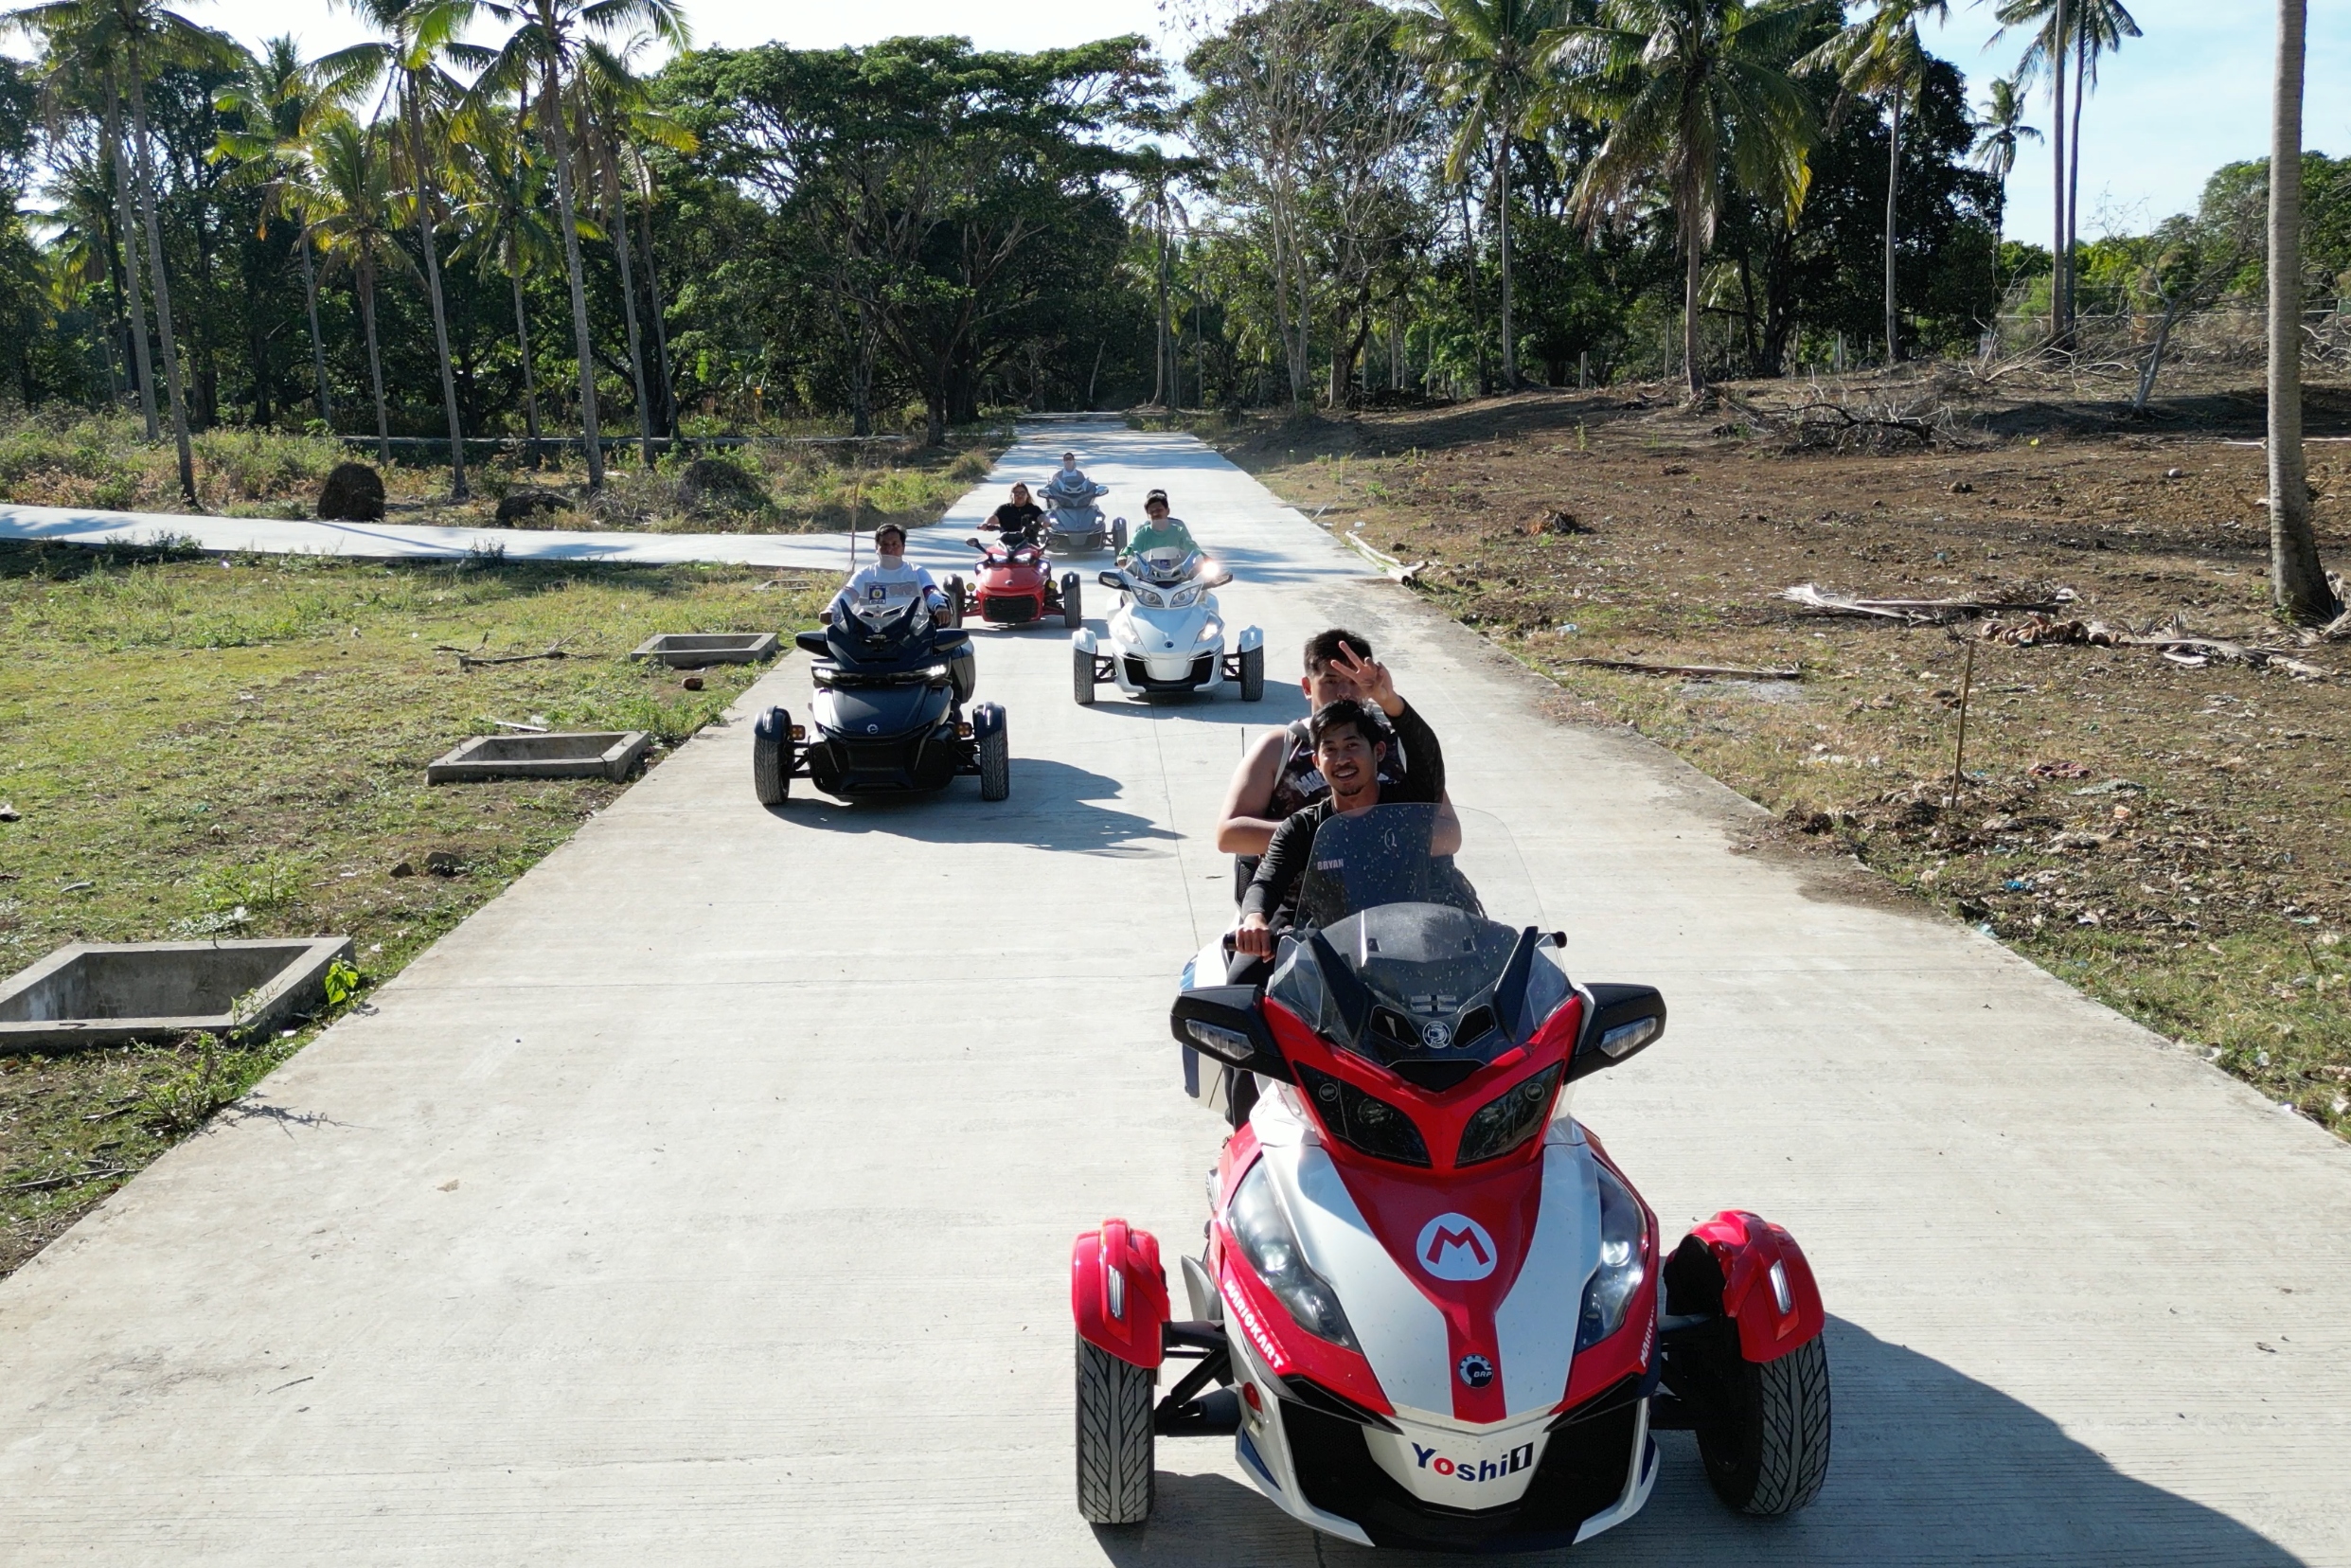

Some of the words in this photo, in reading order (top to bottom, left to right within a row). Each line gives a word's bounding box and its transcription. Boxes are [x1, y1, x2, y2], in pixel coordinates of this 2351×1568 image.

[1317, 858, 1345, 871] BRYAN
[1425, 1224, 1491, 1267] M
[1473, 1370, 1493, 1379] BRP
